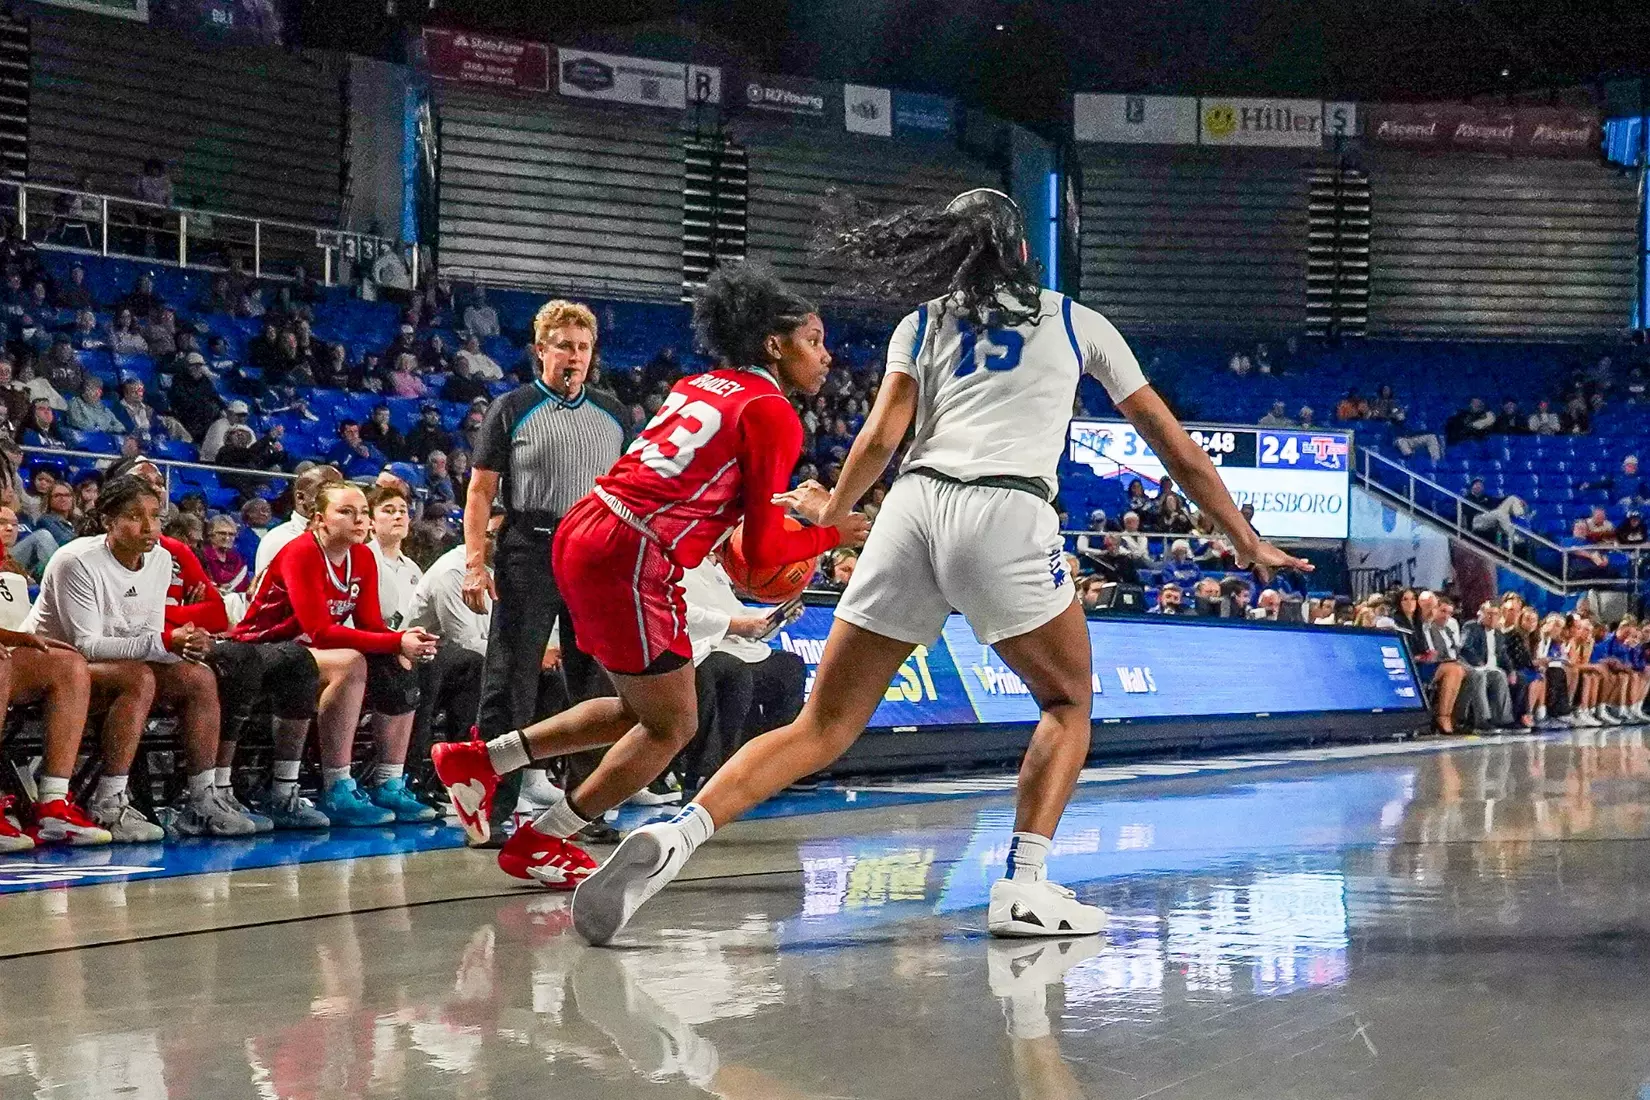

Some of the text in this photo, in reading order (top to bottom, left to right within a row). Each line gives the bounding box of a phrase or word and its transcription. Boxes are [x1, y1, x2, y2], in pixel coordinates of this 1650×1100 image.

[1240, 106, 1322, 131] Hiller
[1261, 435, 1300, 465] 24
[1230, 490, 1342, 514] REESBORO
